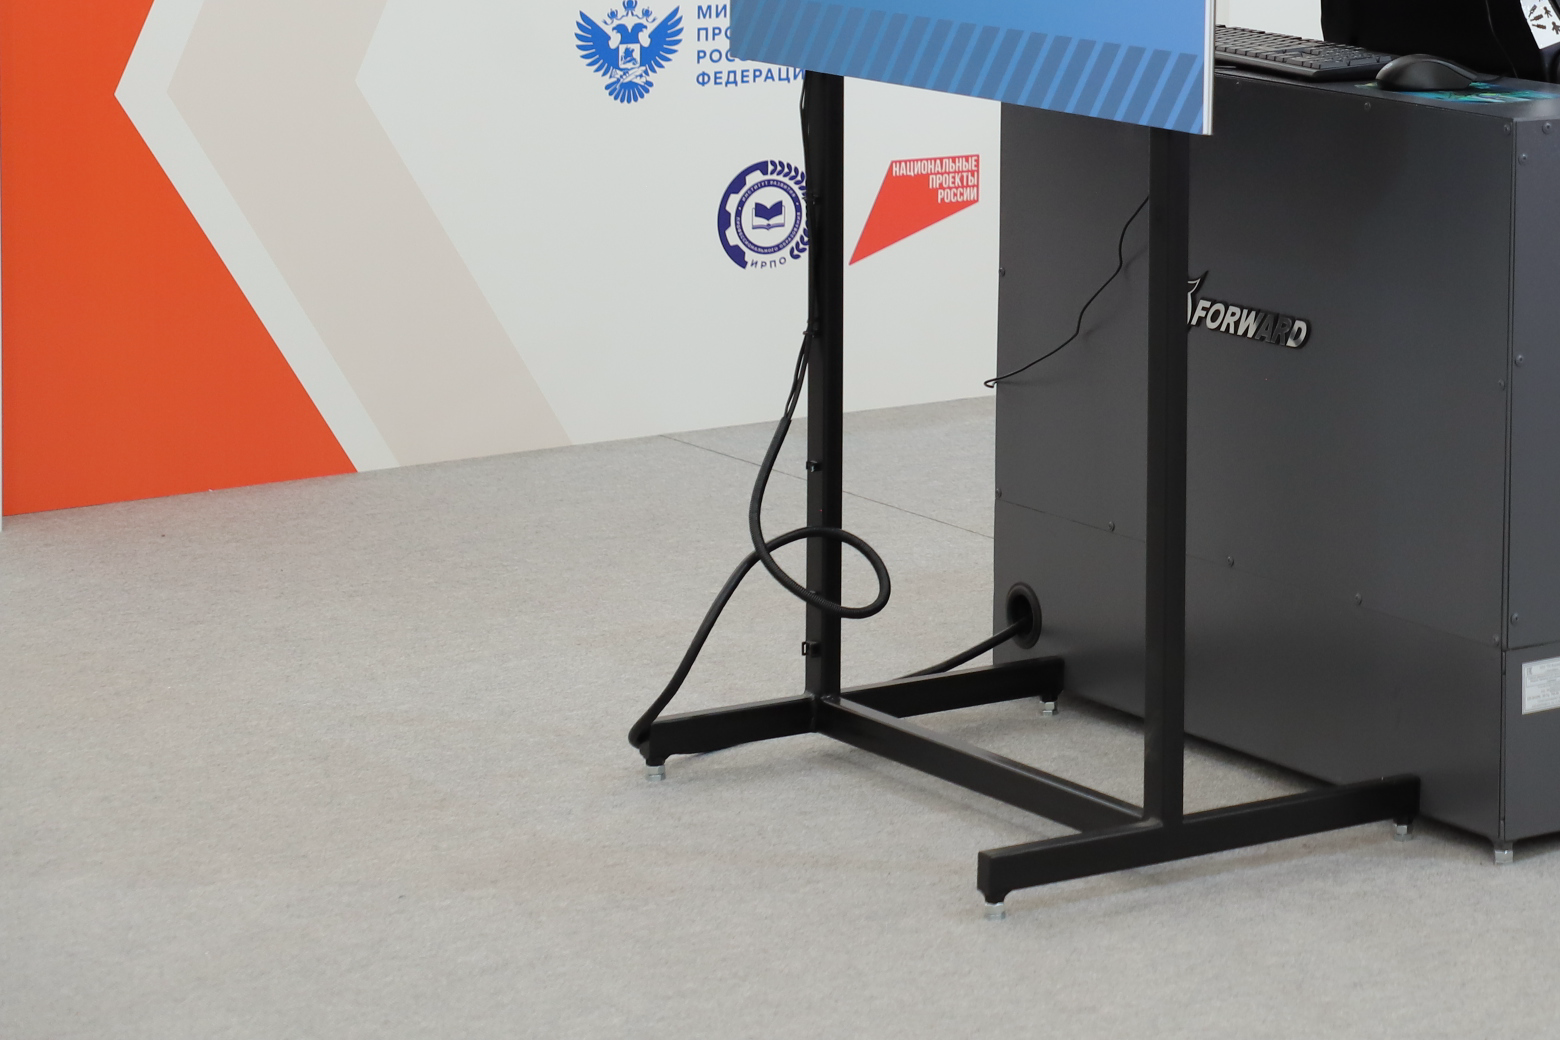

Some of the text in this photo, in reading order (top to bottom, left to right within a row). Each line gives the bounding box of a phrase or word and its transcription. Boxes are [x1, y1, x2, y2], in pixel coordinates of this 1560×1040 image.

[696, 67, 806, 88] ФЕДЕРАЦИ
[892, 156, 978, 177] НАЦИОНАЛЬНЫЕ
[929, 172, 978, 189] ПРОЕКТЫ
[938, 186, 978, 203] РОССИИ
[750, 256, 787, 269] ИРПО
[1191, 299, 1308, 348] FORWARD
